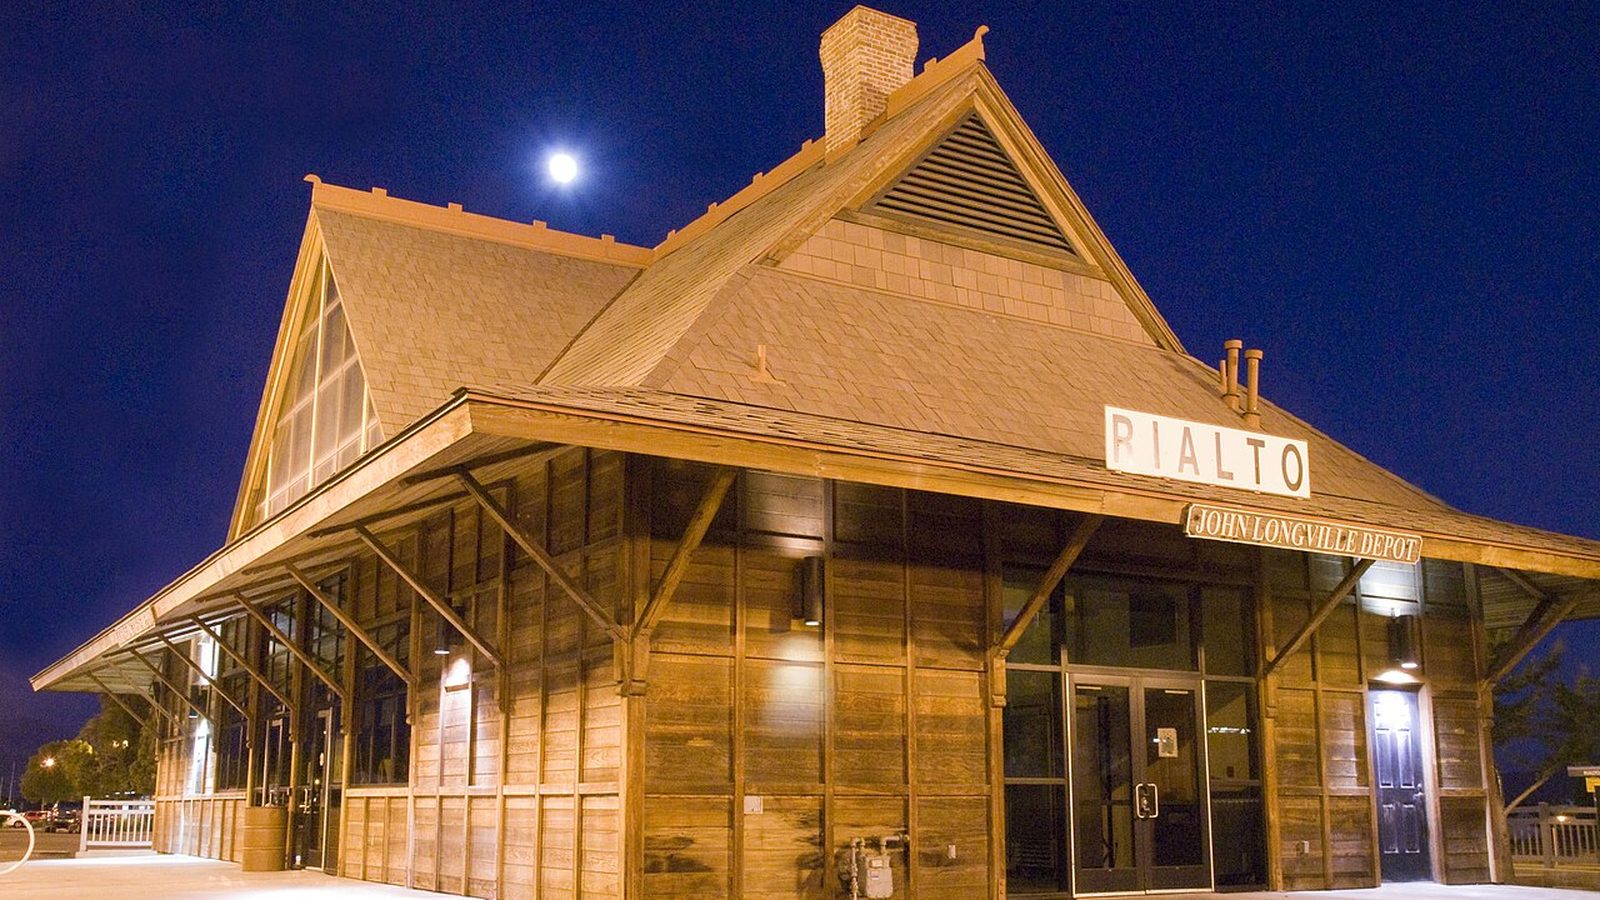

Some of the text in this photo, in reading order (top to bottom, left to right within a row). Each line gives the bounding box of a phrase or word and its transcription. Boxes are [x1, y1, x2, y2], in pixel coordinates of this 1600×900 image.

[1112, 413, 1303, 492] RIALTO
[1195, 508, 1418, 561] JOHN LONGVILLE DEPOT
